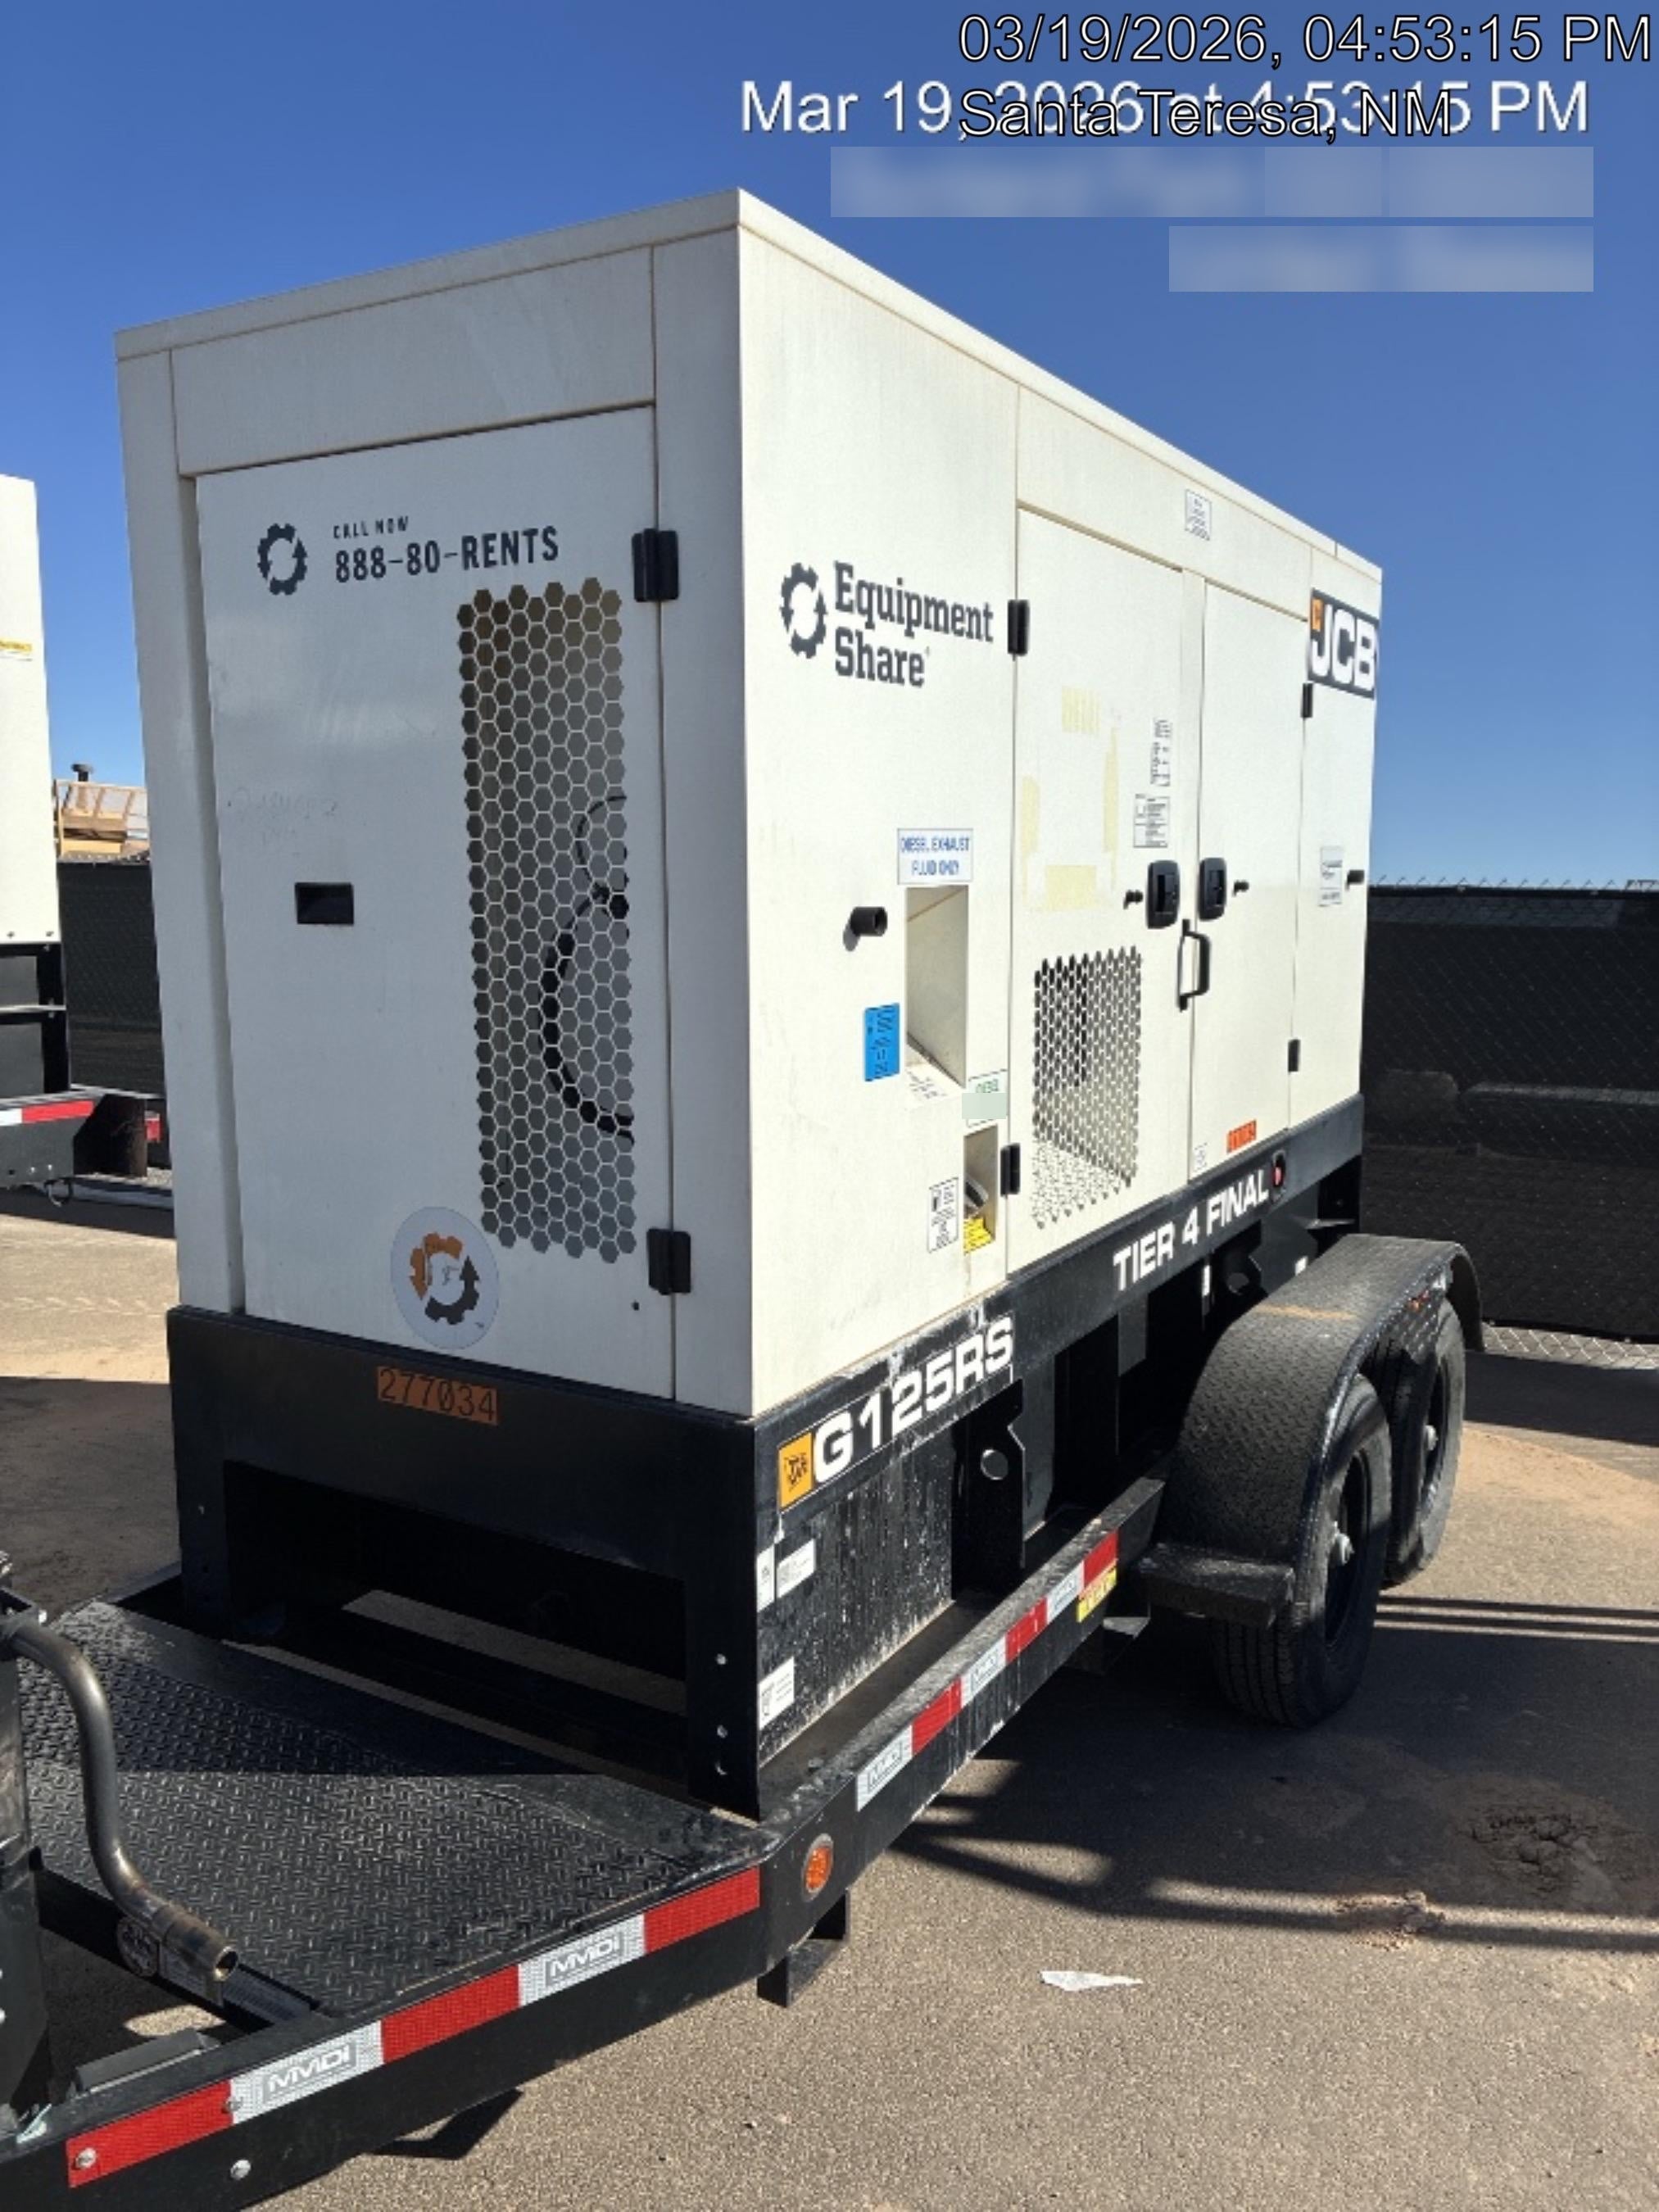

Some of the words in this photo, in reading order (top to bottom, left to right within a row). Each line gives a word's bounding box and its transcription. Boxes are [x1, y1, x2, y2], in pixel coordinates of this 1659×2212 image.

[333, 522, 369, 538] CALL
[374, 515, 410, 534] NOW
[335, 525, 560, 583] 888-80-RENTS
[832, 560, 994, 642] Equipment
[834, 625, 925, 688] Share
[1311, 602, 1378, 691] JCB
[1113, 1222, 1174, 1292] TIER
[1182, 1206, 1199, 1247] 4
[1206, 1167, 1270, 1237] FINAL
[380, 1368, 494, 1421] 277034
[813, 1316, 1014, 1484] G125RS
